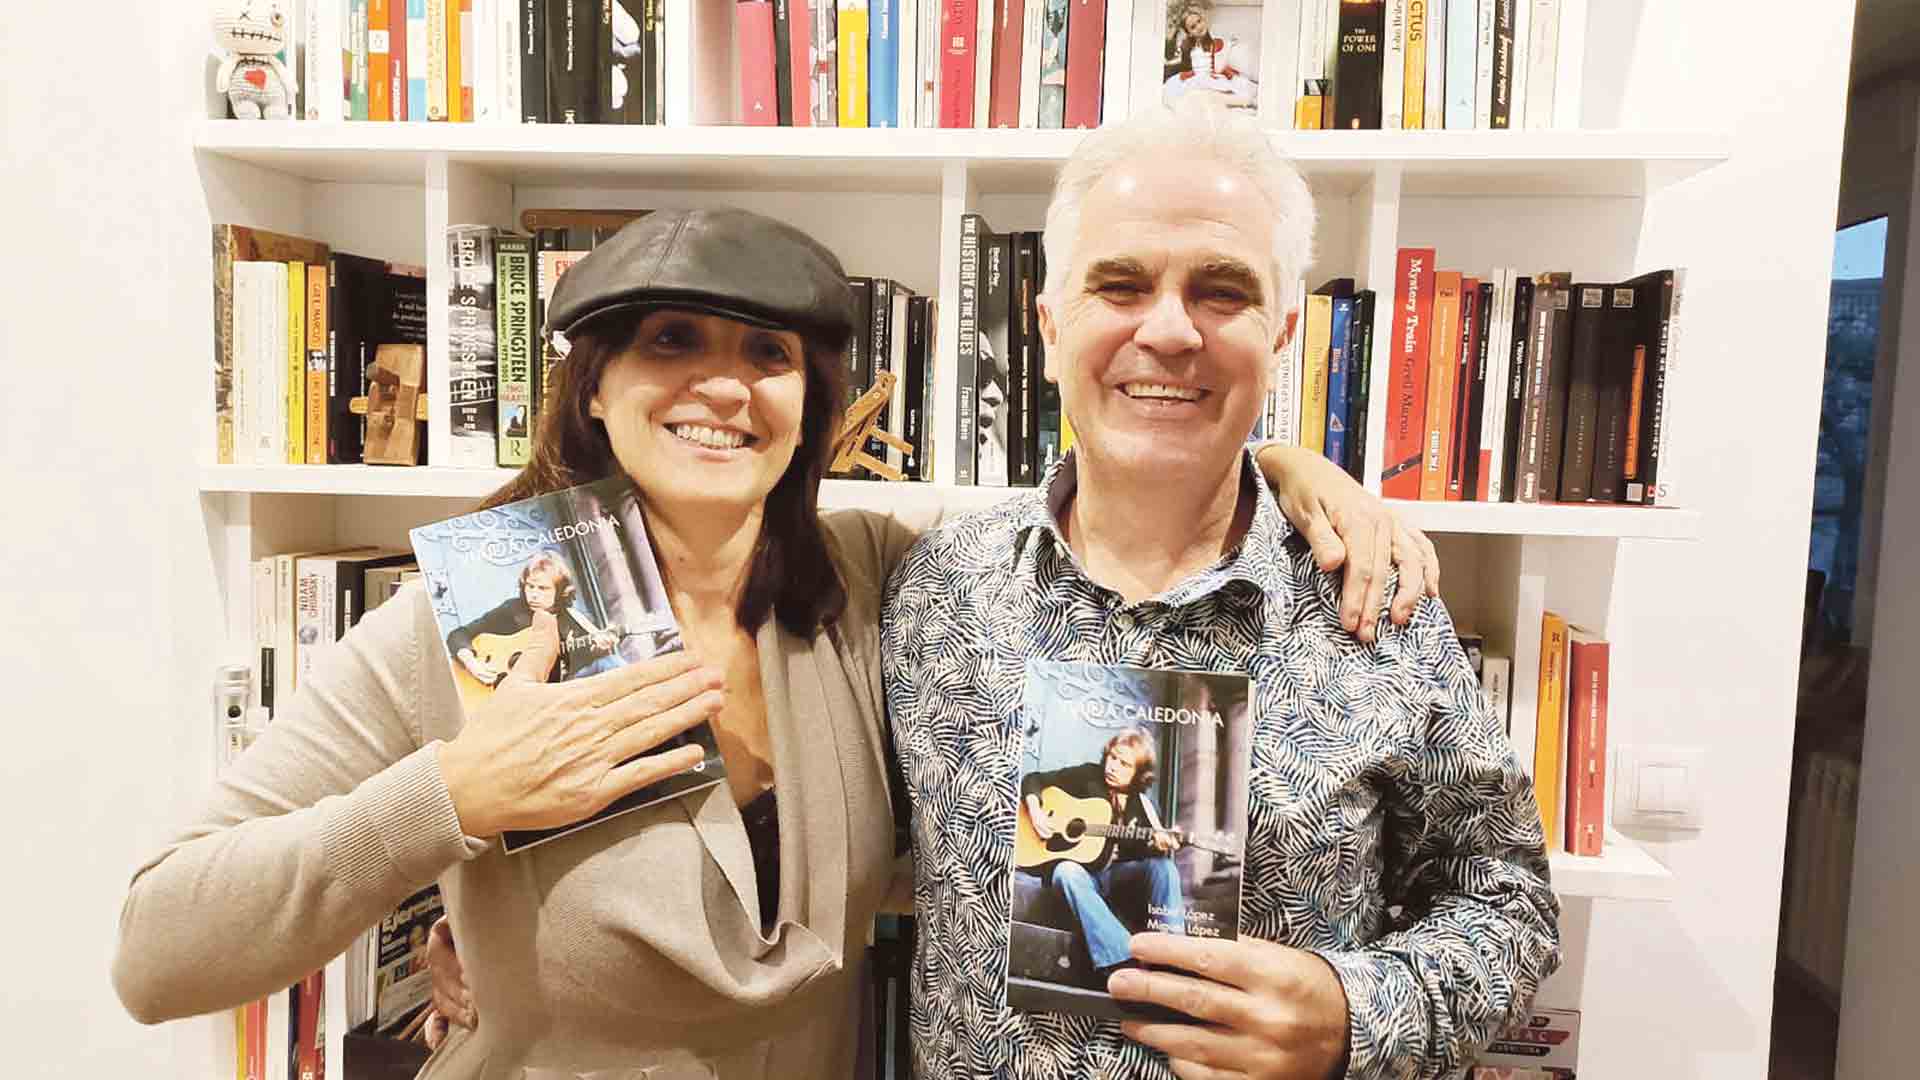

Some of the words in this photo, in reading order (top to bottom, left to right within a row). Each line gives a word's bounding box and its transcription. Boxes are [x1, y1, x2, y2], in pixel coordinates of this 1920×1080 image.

[1343, 34, 1376, 44] POWER
[461, 239, 477, 290] BRUE
[510, 255, 526, 295] BRUCE
[961, 236, 975, 286] HISTORY
[1405, 258, 1422, 312] Mystery
[511, 301, 527, 383] SPRINGSTEEN
[960, 319, 974, 356] BLUES
[1404, 315, 1419, 353] Train
[531, 514, 620, 553] CALEDONIA
[1123, 704, 1225, 728] CALEDONIA
[1147, 903, 1181, 917] Isab
[1188, 921, 1221, 938] López
